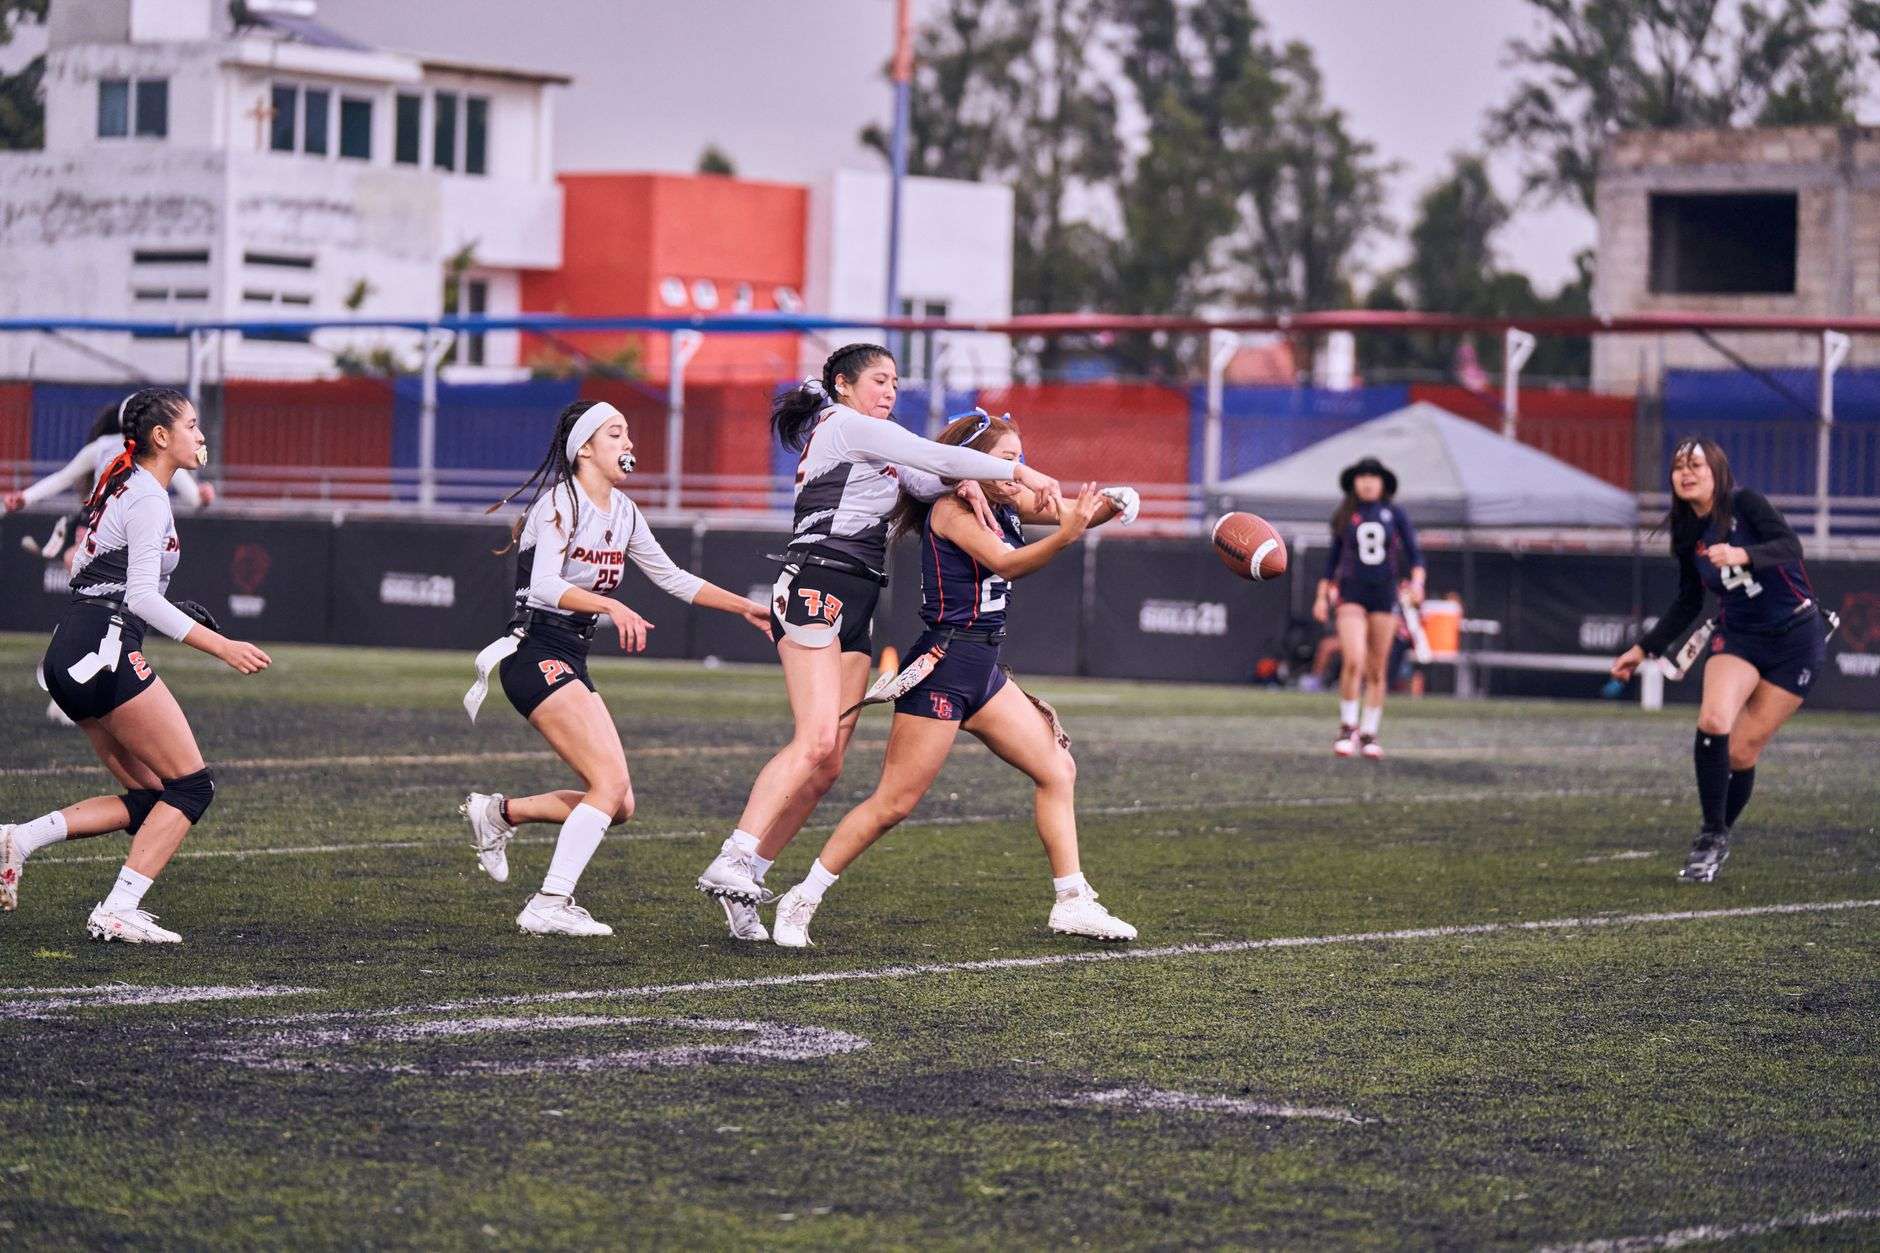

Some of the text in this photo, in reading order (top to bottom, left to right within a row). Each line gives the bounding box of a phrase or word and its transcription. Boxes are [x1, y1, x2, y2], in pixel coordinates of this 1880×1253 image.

[570, 546, 625, 565] PANTER
[1356, 521, 1386, 566] 8
[591, 568, 620, 593] 25
[1720, 563, 1764, 598] 4
[797, 588, 844, 626] 72
